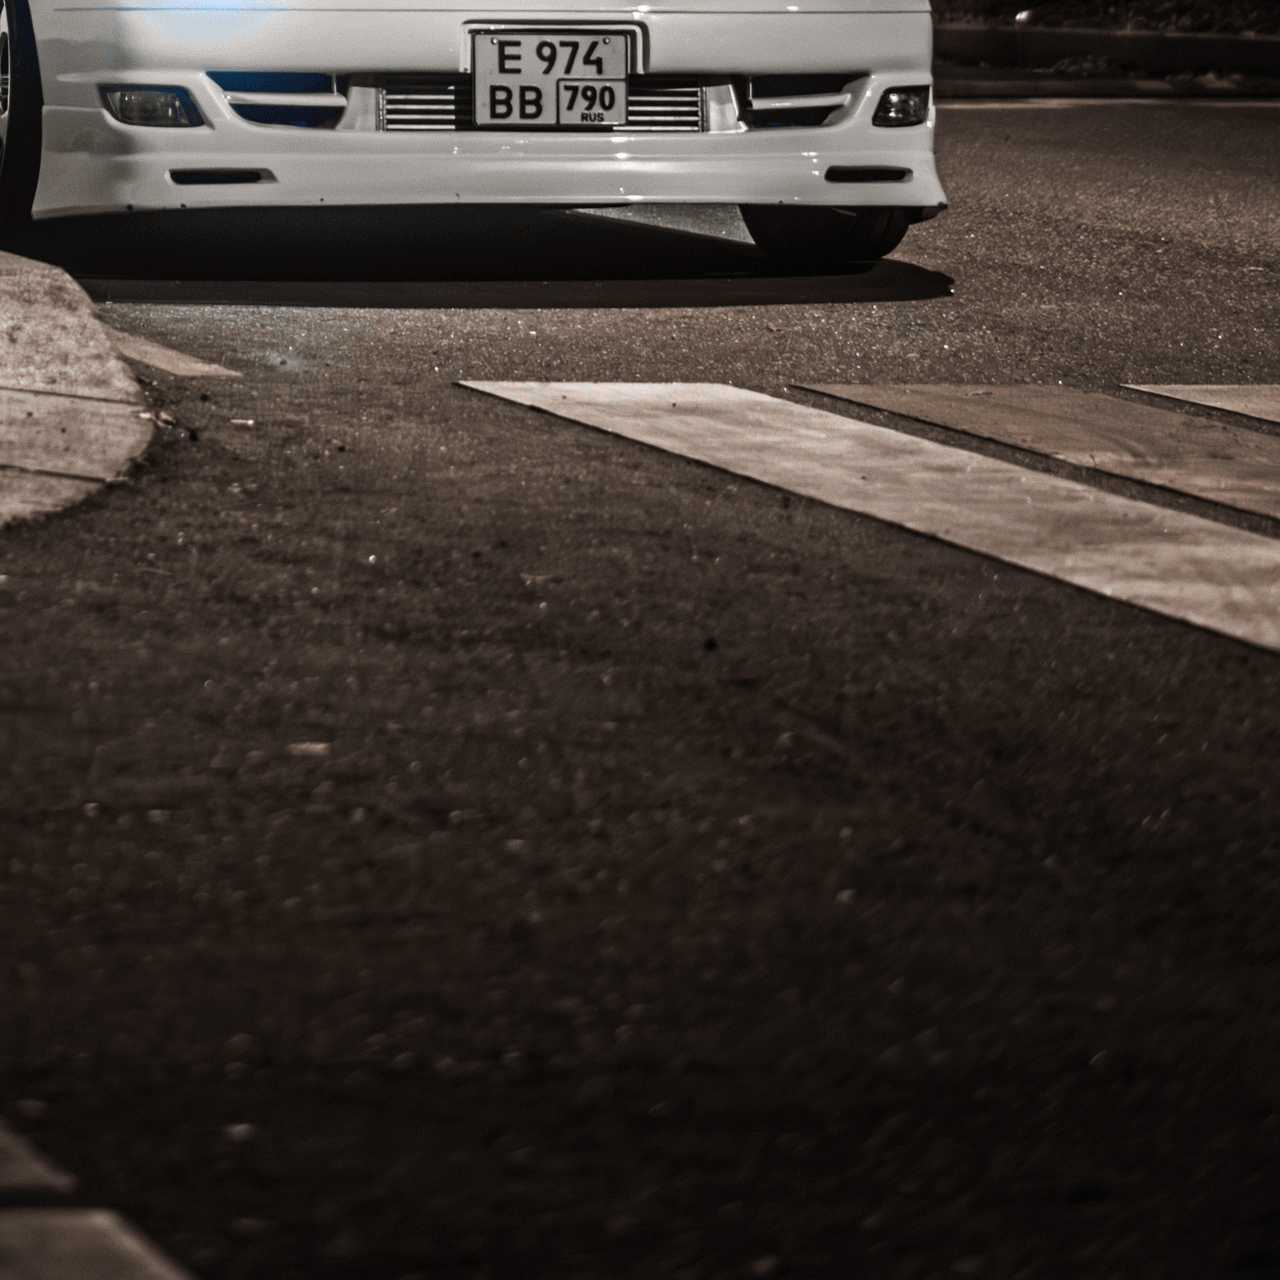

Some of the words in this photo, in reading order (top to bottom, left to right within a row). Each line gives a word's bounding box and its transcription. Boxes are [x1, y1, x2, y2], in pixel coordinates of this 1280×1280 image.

[498, 40, 522, 74] E
[535, 40, 604, 75] 974
[489, 84, 543, 119] BB
[563, 84, 616, 111] 790
[580, 112, 605, 122] RUS
